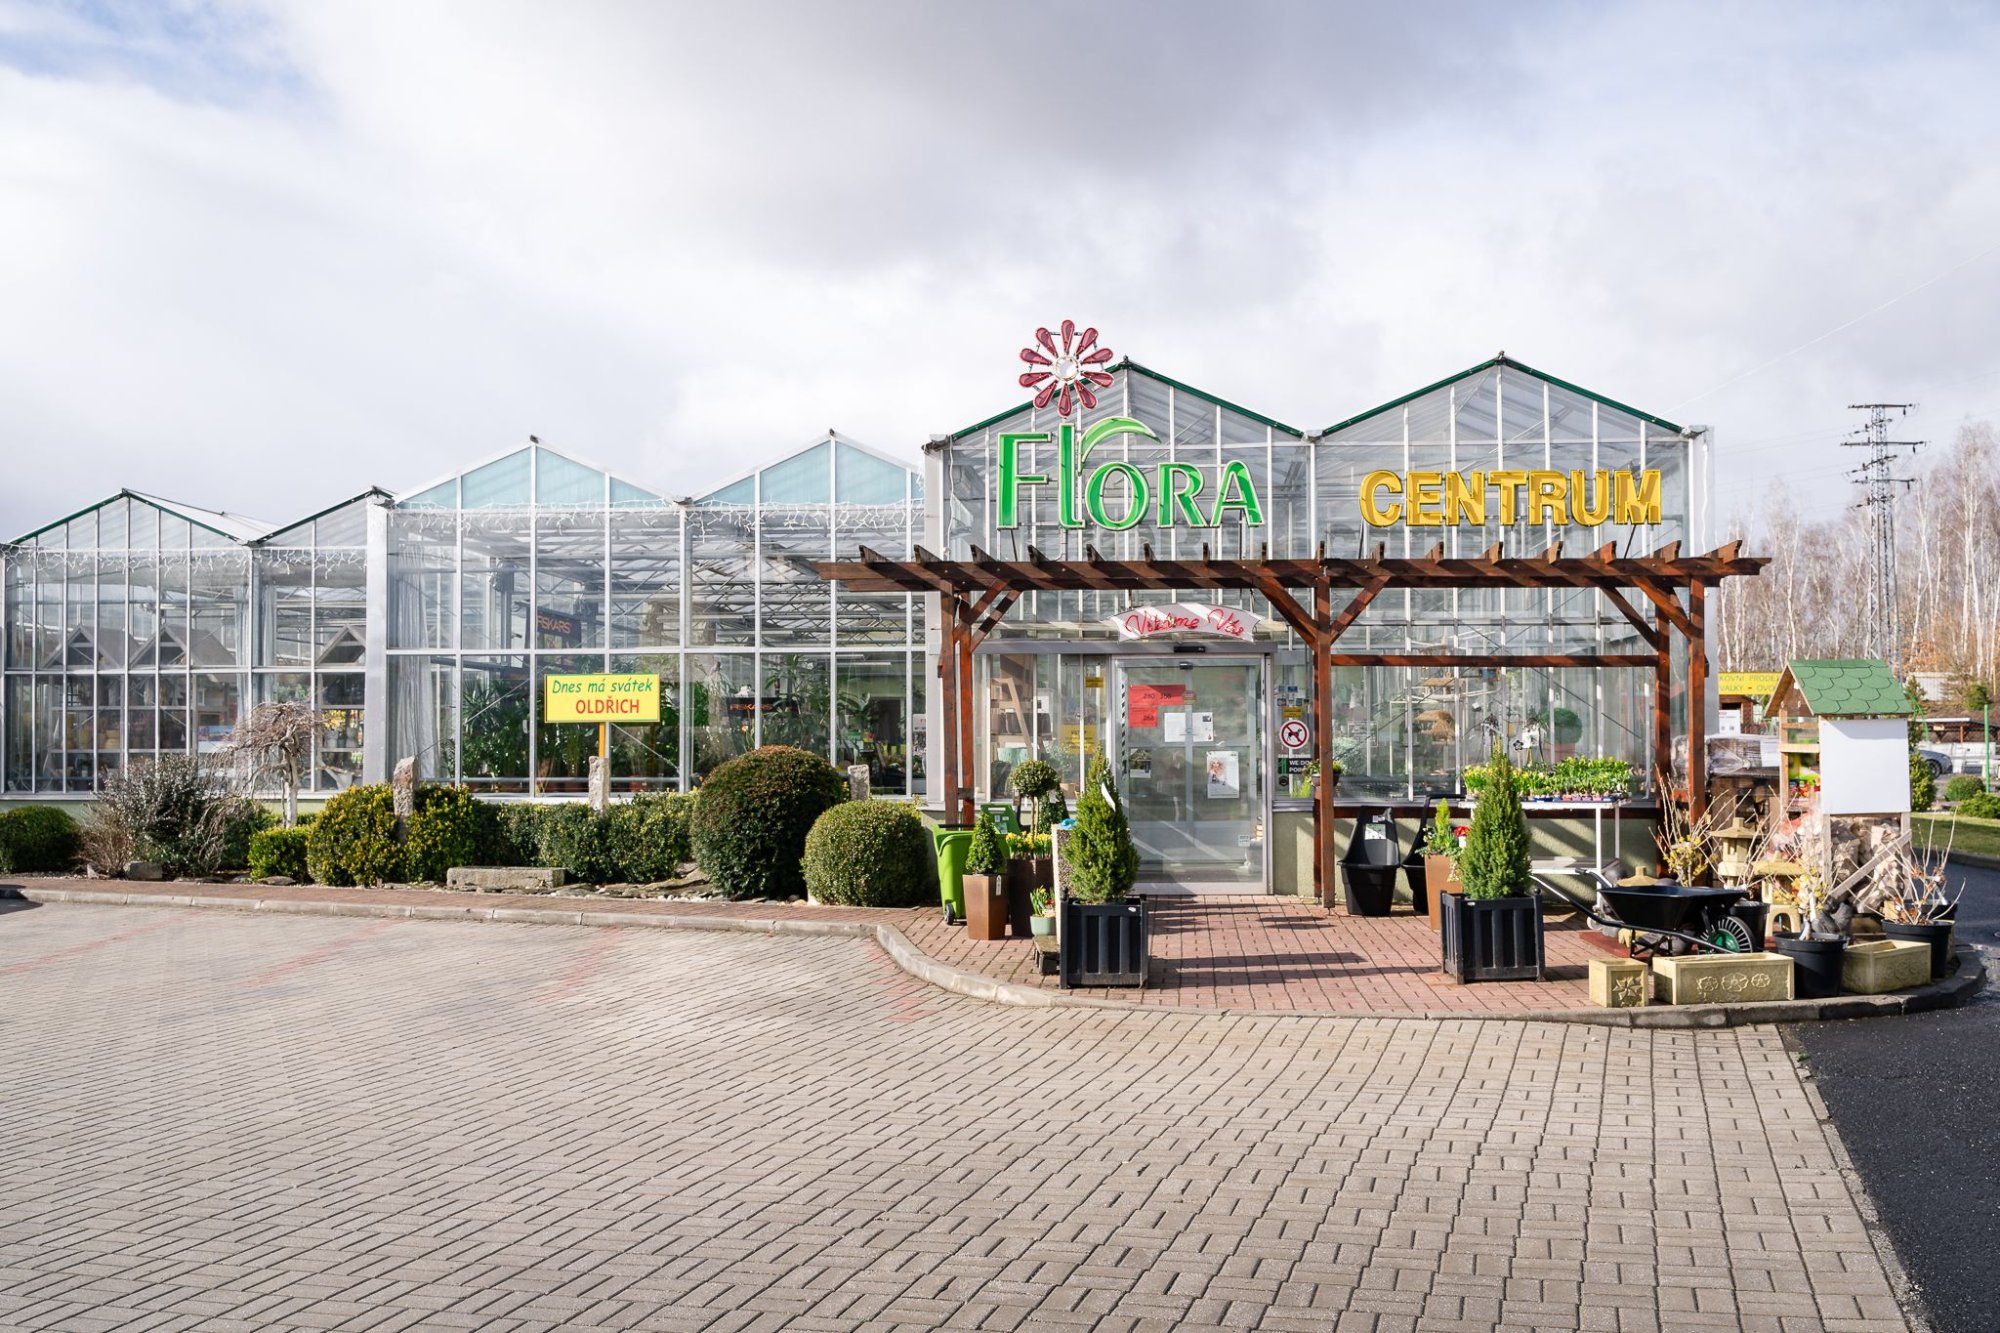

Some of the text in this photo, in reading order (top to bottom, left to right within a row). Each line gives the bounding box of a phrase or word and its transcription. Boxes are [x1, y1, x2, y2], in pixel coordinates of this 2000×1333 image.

[1359, 469, 1663, 527] CENTRUM
[552, 677, 653, 694] Dnes má svátek
[575, 695, 640, 714] OLDŘICH
